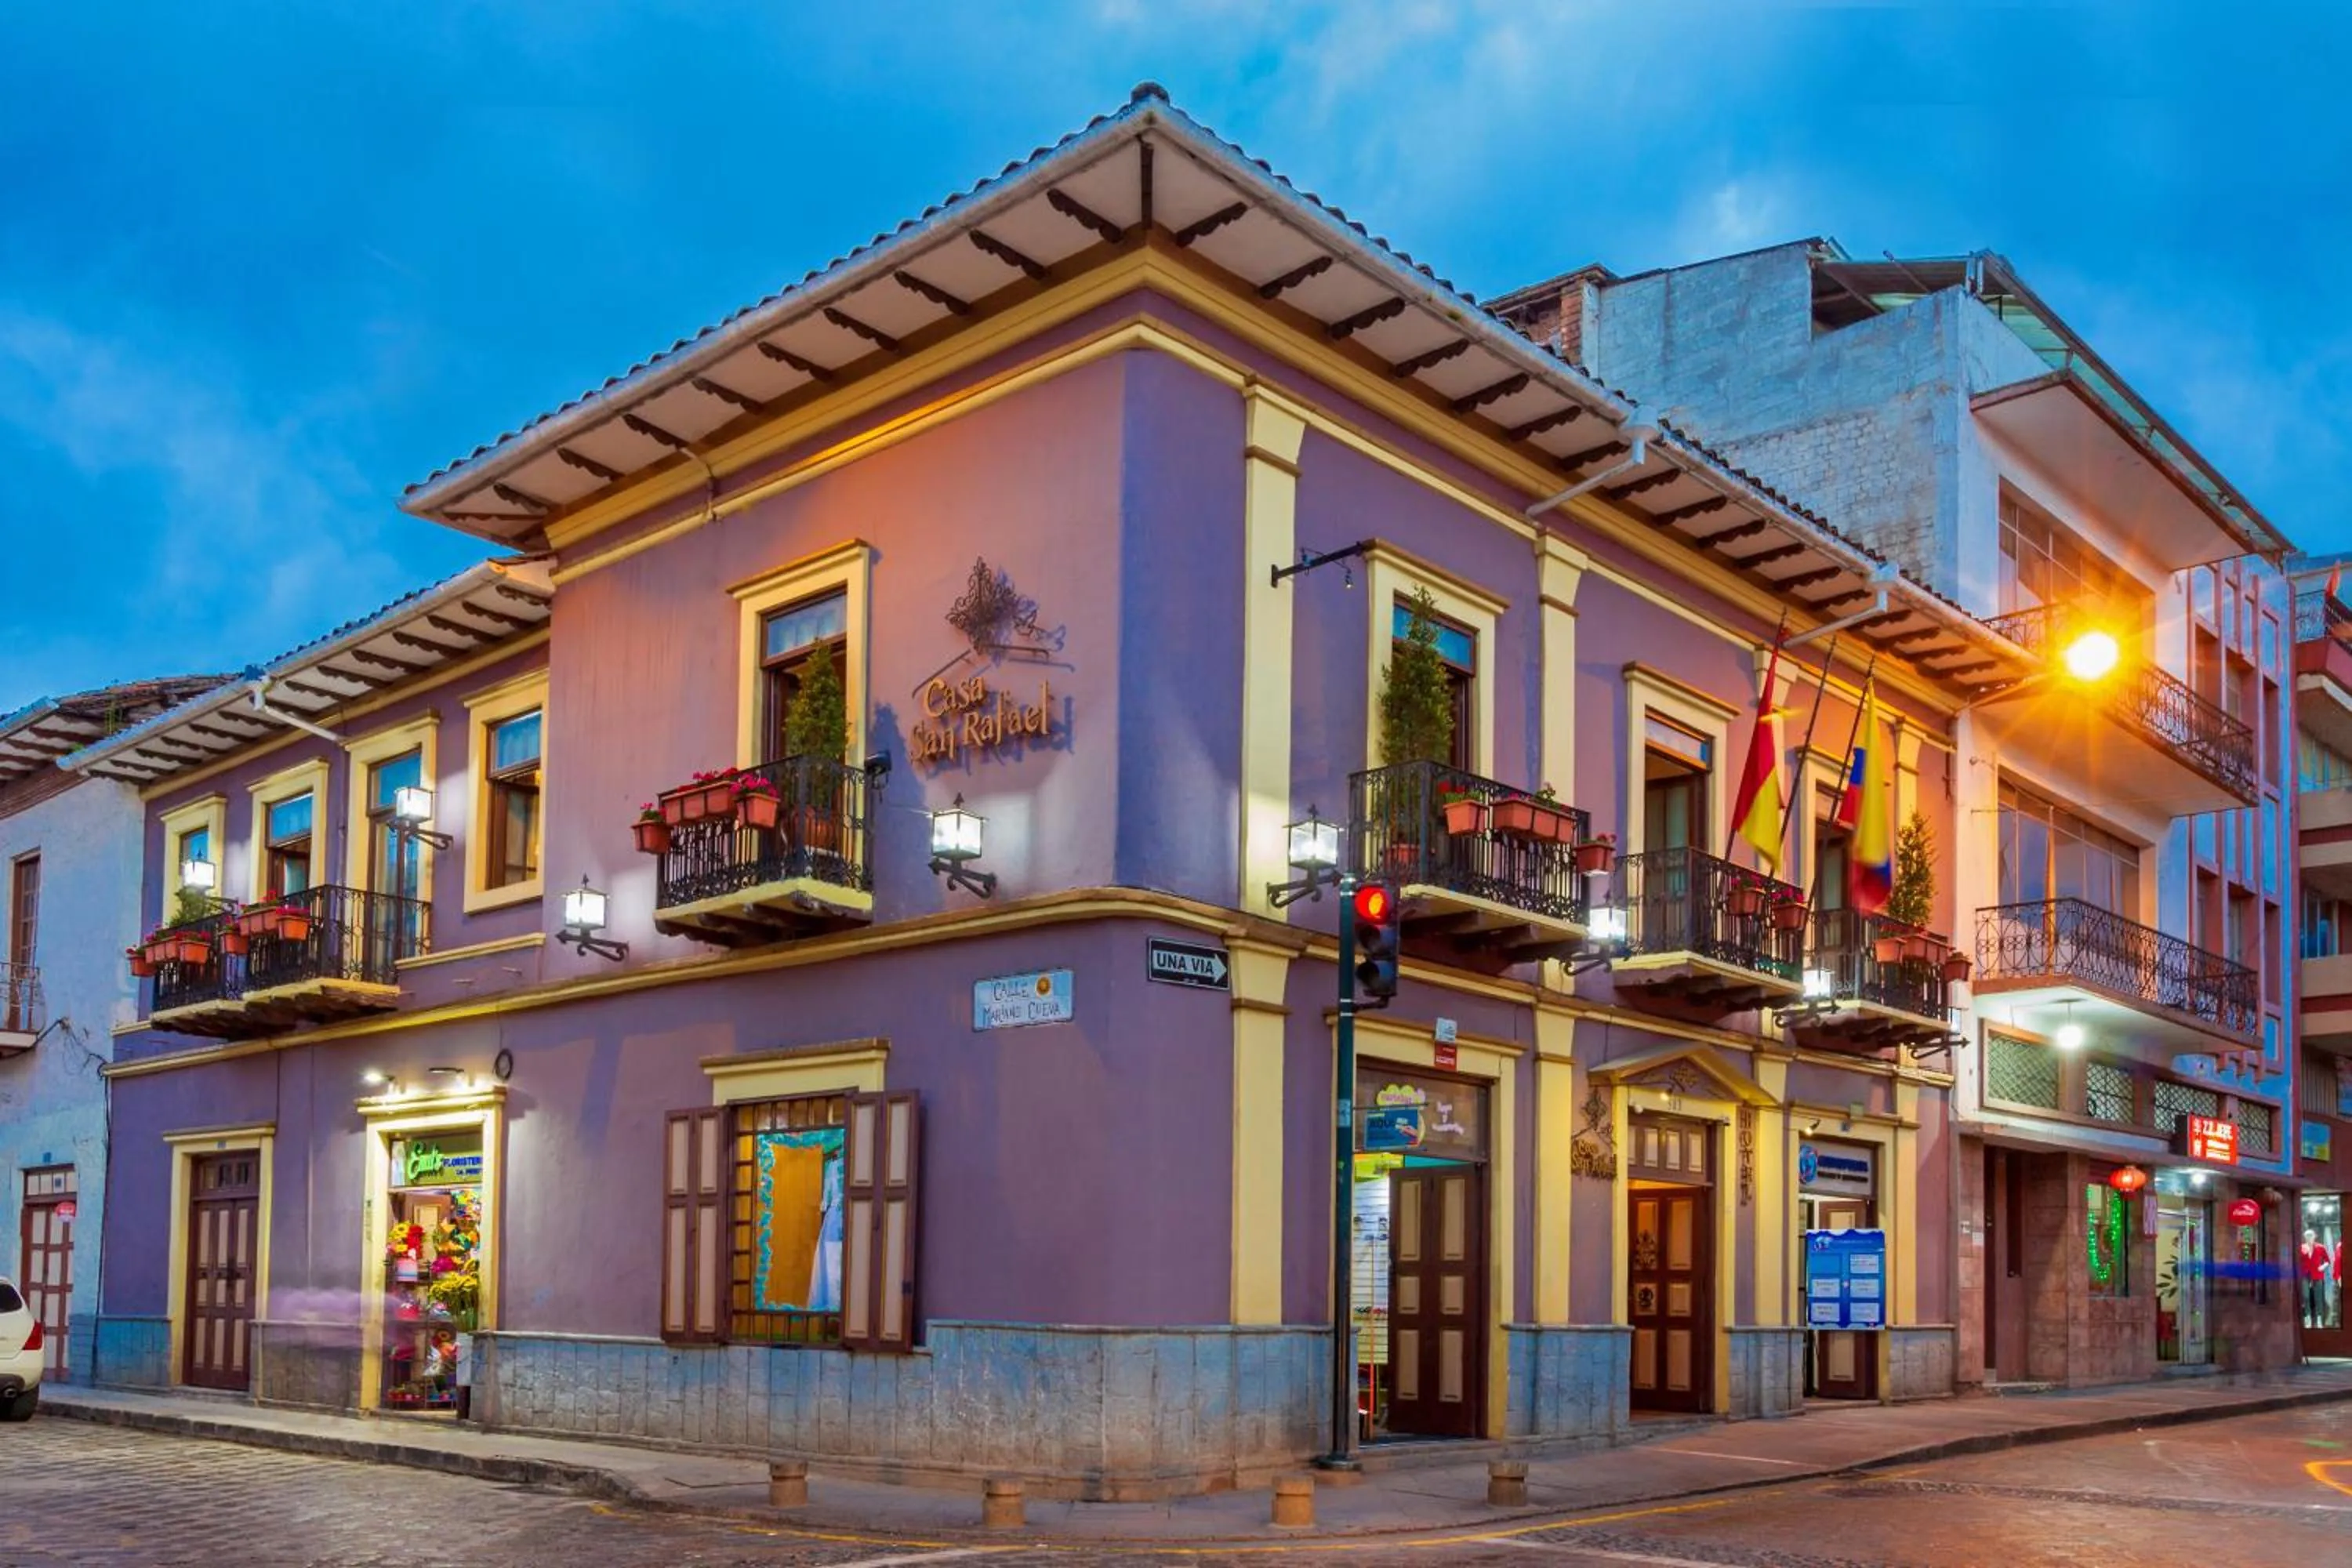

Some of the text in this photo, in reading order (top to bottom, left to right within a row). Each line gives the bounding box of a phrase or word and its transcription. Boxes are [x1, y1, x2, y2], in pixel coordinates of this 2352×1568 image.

[924, 677, 985, 717] Casa
[911, 680, 1049, 760] San Rafael
[1156, 953, 1214, 975] UNA VIA
[993, 981, 1029, 1001] CALLE
[1028, 1001, 1061, 1019] CUEVA
[1739, 1107, 1754, 1200] HOTEL
